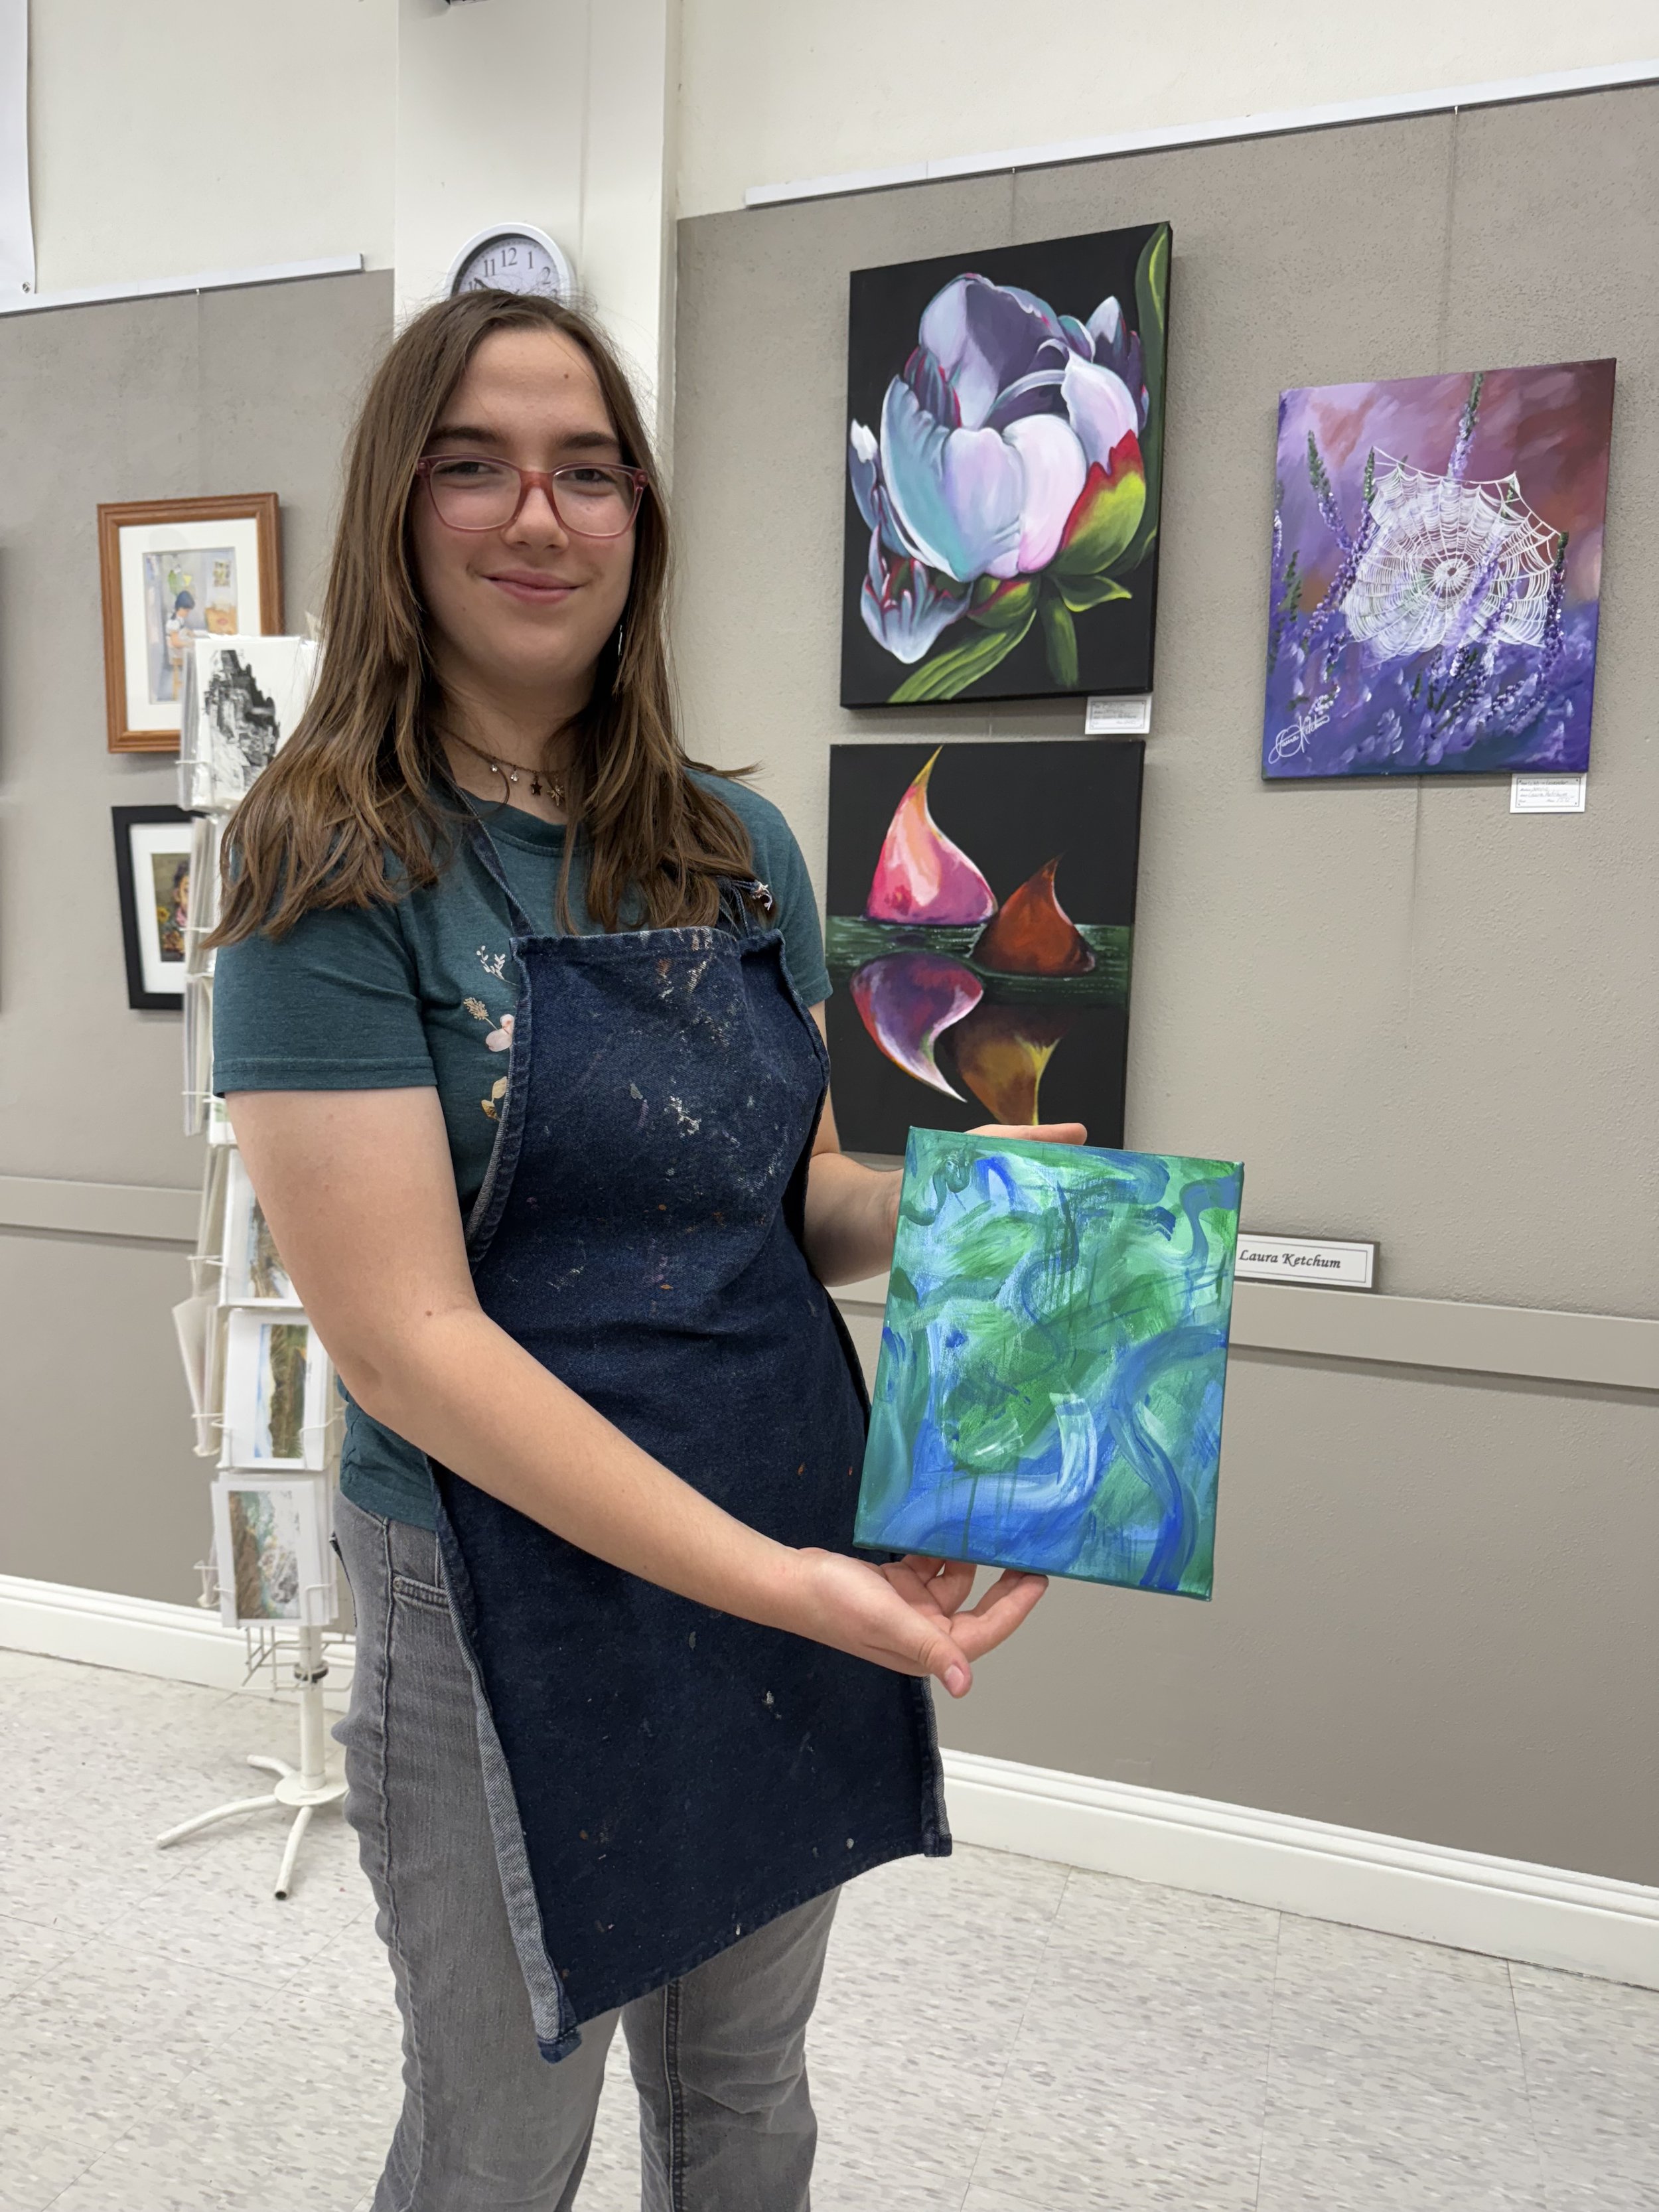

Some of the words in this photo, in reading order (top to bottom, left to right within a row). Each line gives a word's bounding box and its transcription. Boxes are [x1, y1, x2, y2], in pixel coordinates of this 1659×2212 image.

[501, 247, 518, 267] 12
[528, 250, 534, 269] 1
[484, 258, 496, 277] 11
[541, 266, 551, 285] 2
[1238, 1249, 1279, 1264] Laura
[1281, 1252, 1341, 1269] Ketchum
